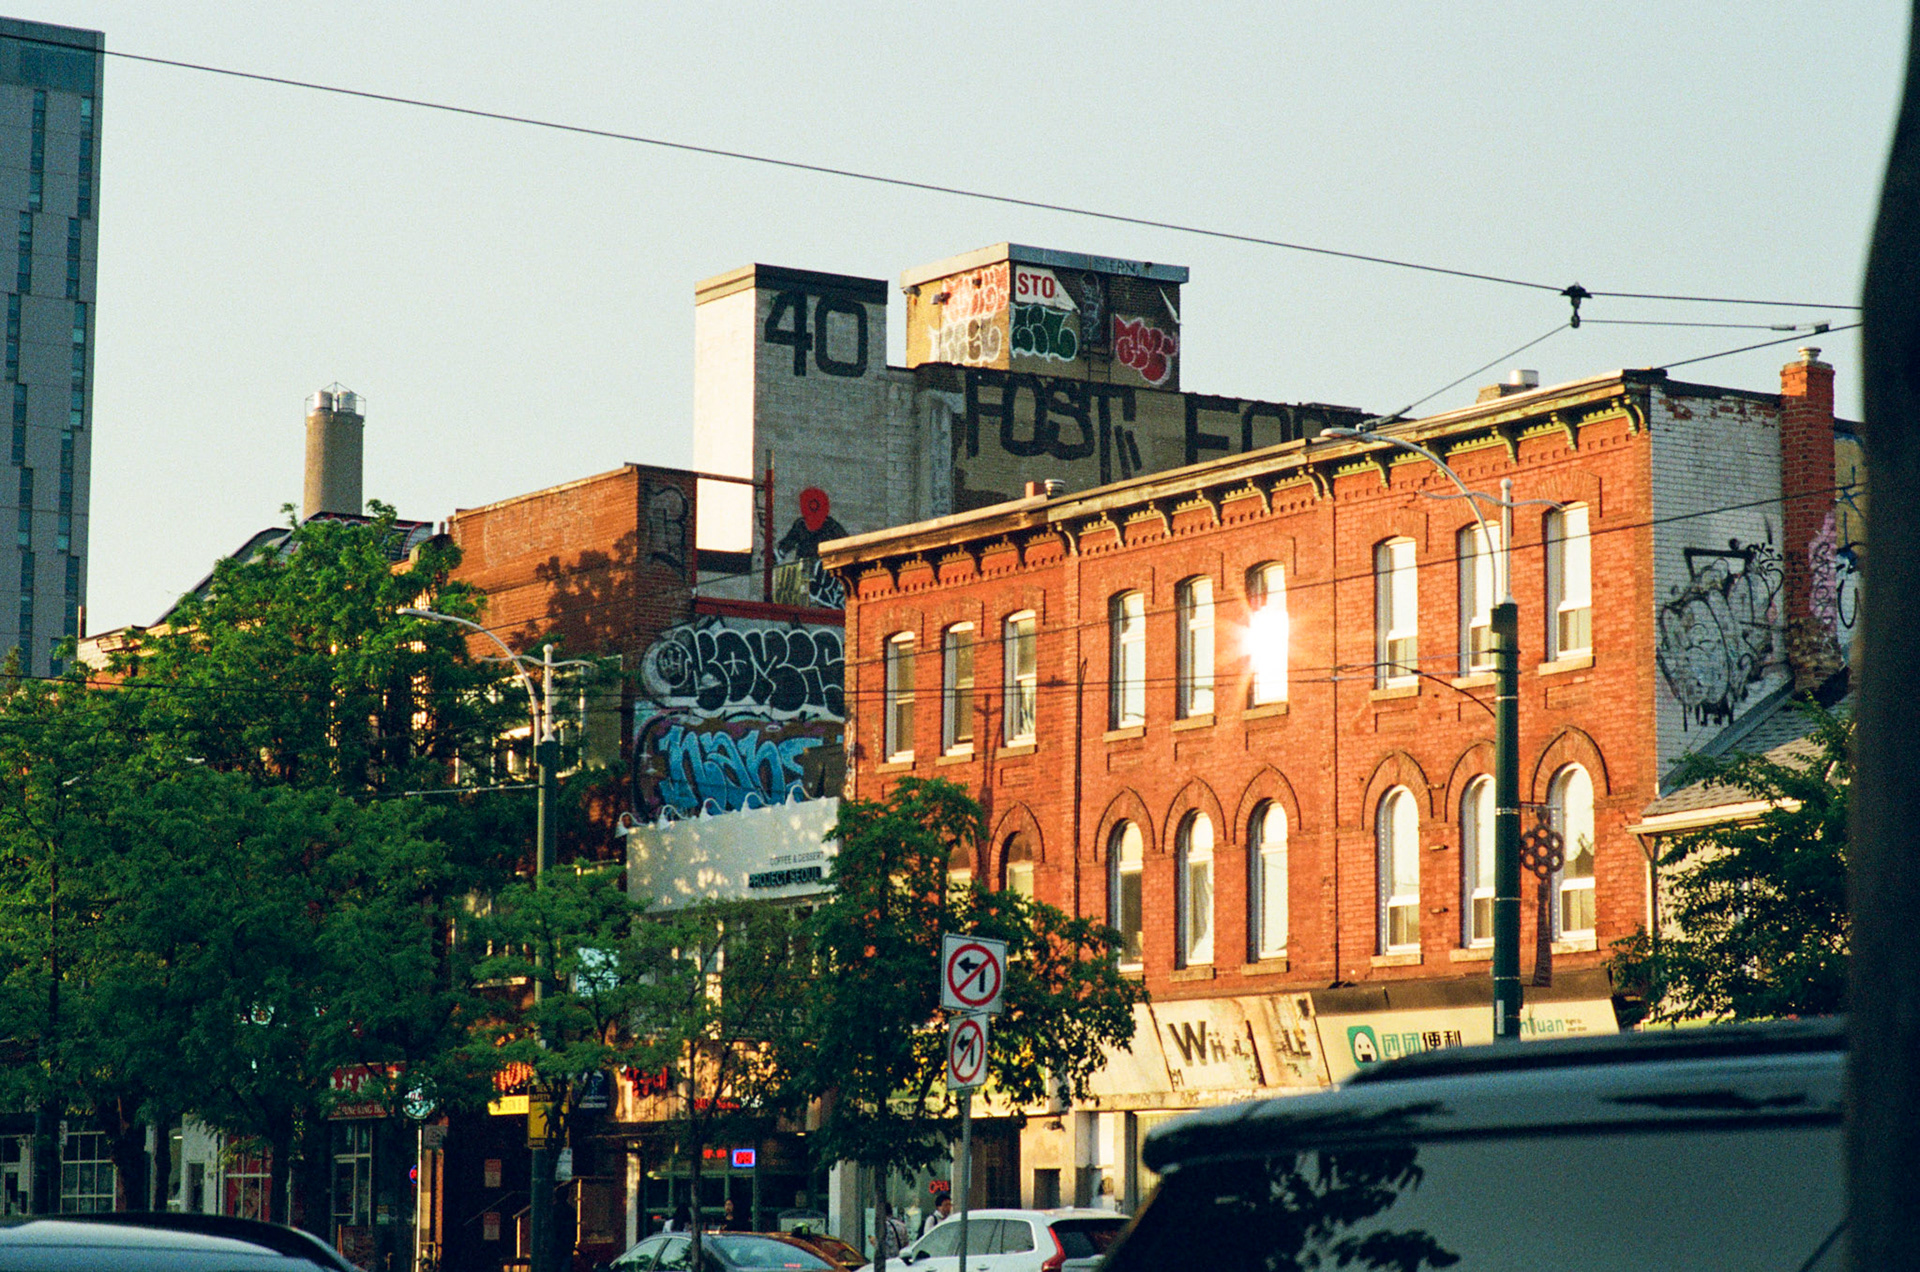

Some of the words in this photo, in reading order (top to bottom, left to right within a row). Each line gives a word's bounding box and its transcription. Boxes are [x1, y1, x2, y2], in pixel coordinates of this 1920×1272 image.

[763, 291, 868, 378] 40
[770, 855, 792, 866] COFFEE
[798, 851, 824, 862] DESSERT
[748, 869, 788, 888] PROJECT
[789, 866, 822, 883] SEOUL
